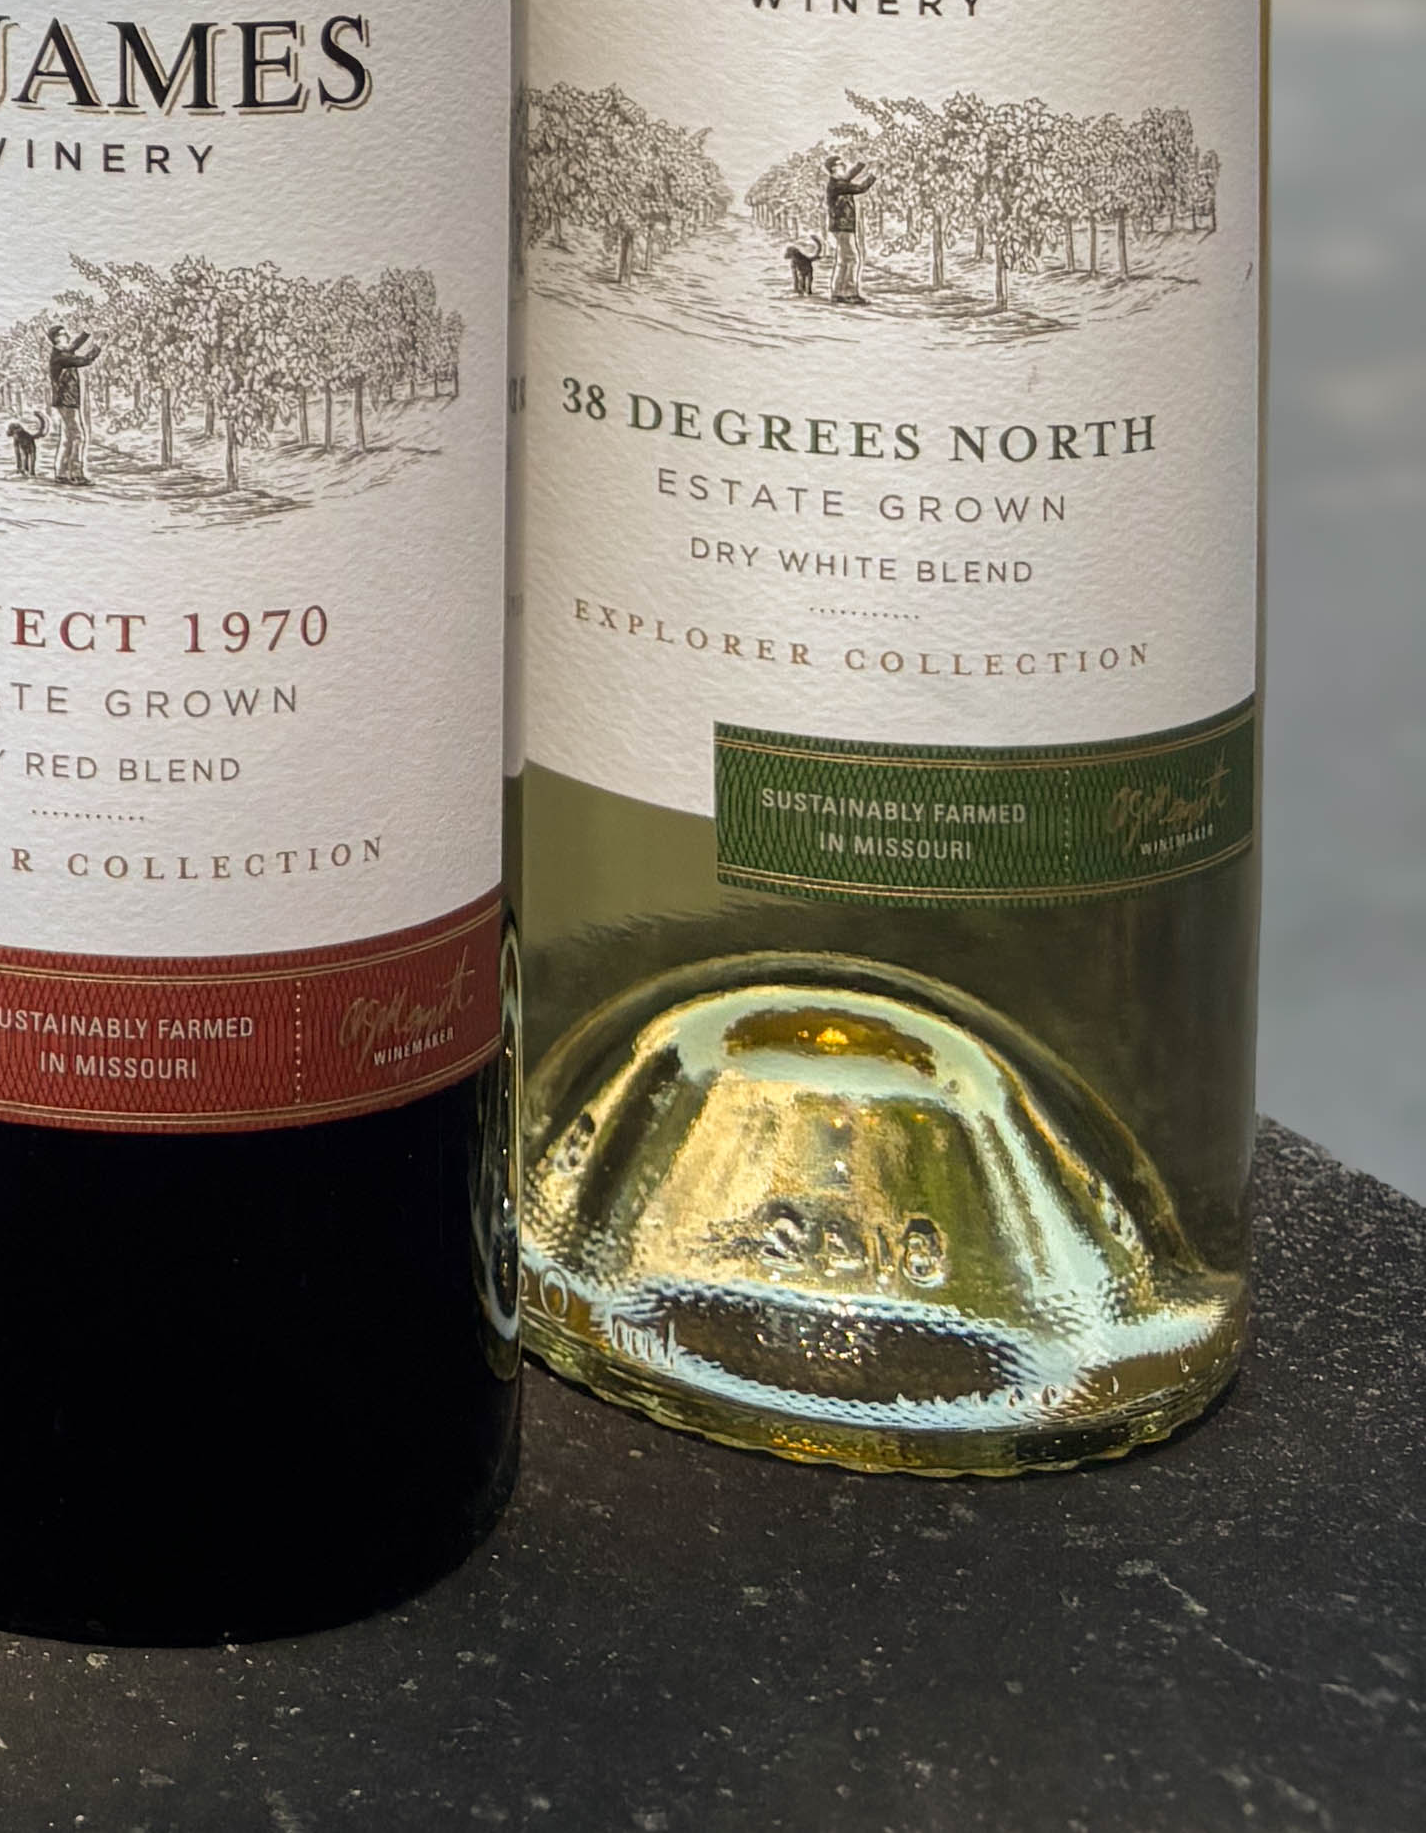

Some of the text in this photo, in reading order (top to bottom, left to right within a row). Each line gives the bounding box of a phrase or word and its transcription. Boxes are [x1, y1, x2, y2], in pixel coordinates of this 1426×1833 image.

[561, 377, 607, 421] 38
[627, 392, 922, 461] DEGREES
[949, 414, 1157, 465] NORTH
[658, 468, 1067, 524] ESTATE GROWN
[690, 536, 1034, 585] DRY WHITE BLEND
[183, 604, 329, 654] 1970
[574, 598, 811, 666] EXPLORER
[844, 642, 1149, 677] COLLECTION
[104, 685, 298, 719] GROWN
[25, 752, 97, 781] RED
[119, 757, 242, 784] BLEND
[761, 788, 1026, 825] SUSTAINABLY FARMED
[67, 836, 384, 881] COLLECTION
[819, 832, 972, 861] IN MISSOURI
[157, 1017, 253, 1039] FARMED
[373, 1027, 454, 1066] WINEMAKER
[40, 1053, 197, 1081] IN MISSOURI
